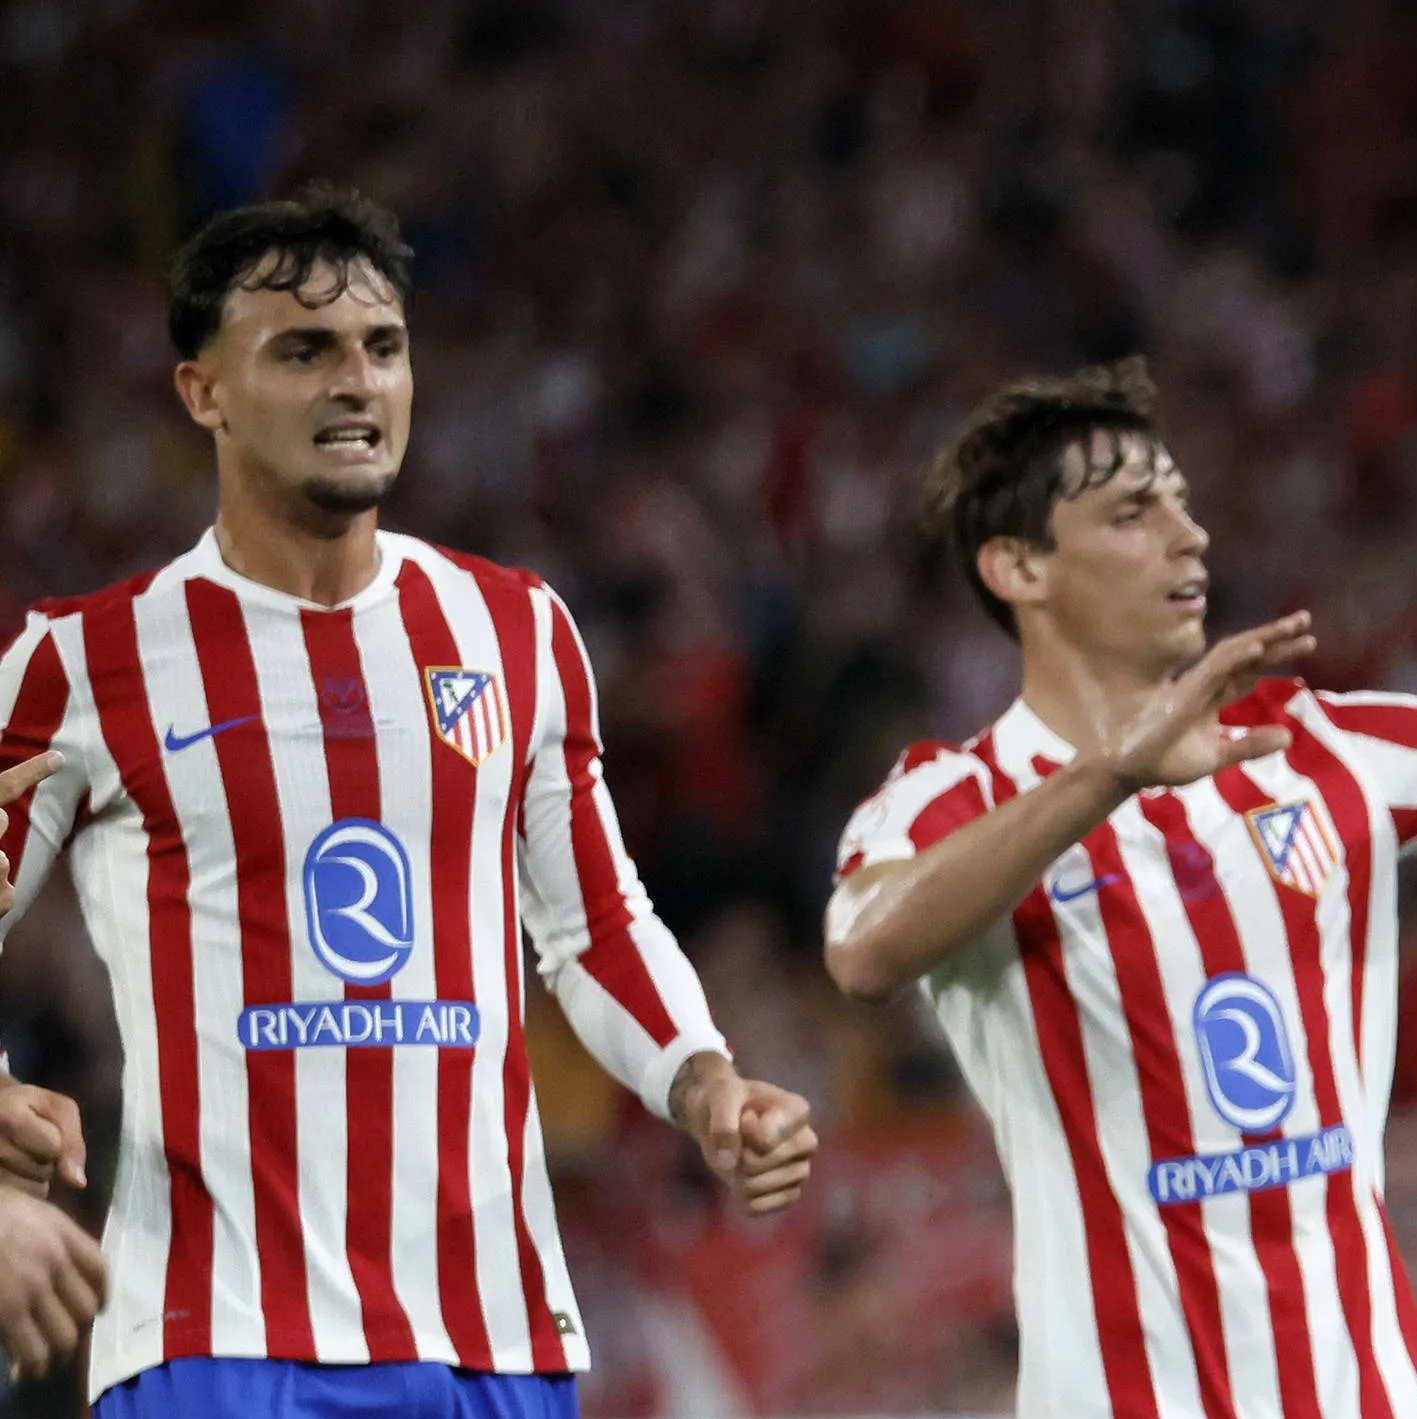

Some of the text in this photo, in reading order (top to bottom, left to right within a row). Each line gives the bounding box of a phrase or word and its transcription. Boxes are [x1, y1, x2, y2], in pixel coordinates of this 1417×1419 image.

[249, 1004, 474, 1047] RIYADH AIR
[1156, 1126, 1355, 1203] RIYADH AIR
